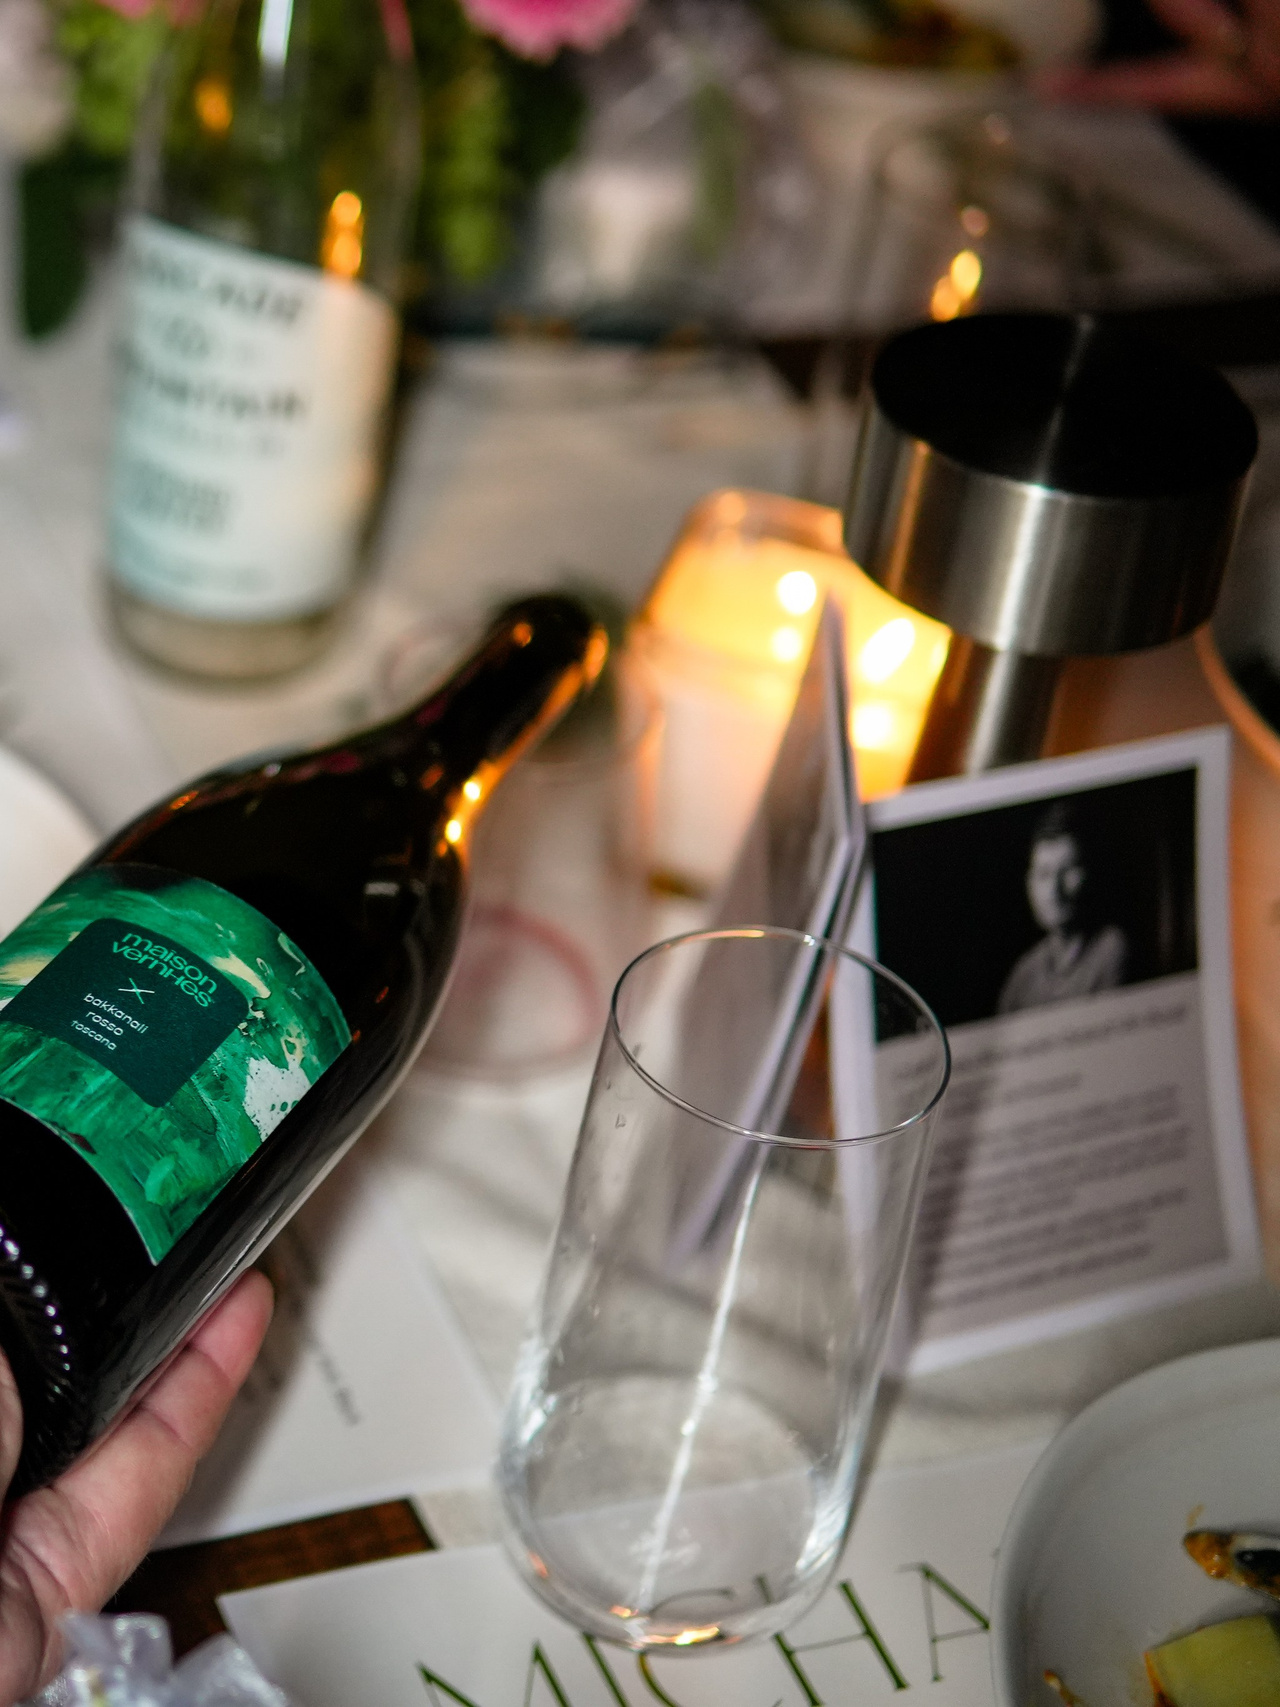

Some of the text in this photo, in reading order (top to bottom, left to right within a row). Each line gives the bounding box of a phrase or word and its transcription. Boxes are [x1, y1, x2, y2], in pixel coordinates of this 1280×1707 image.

[121, 932, 218, 994] maison
[83, 992, 150, 1034] bakkanali
[85, 1011, 124, 1036] rosso
[70, 1020, 117, 1051] toscana
[414, 1548, 1002, 1707] MICHA
